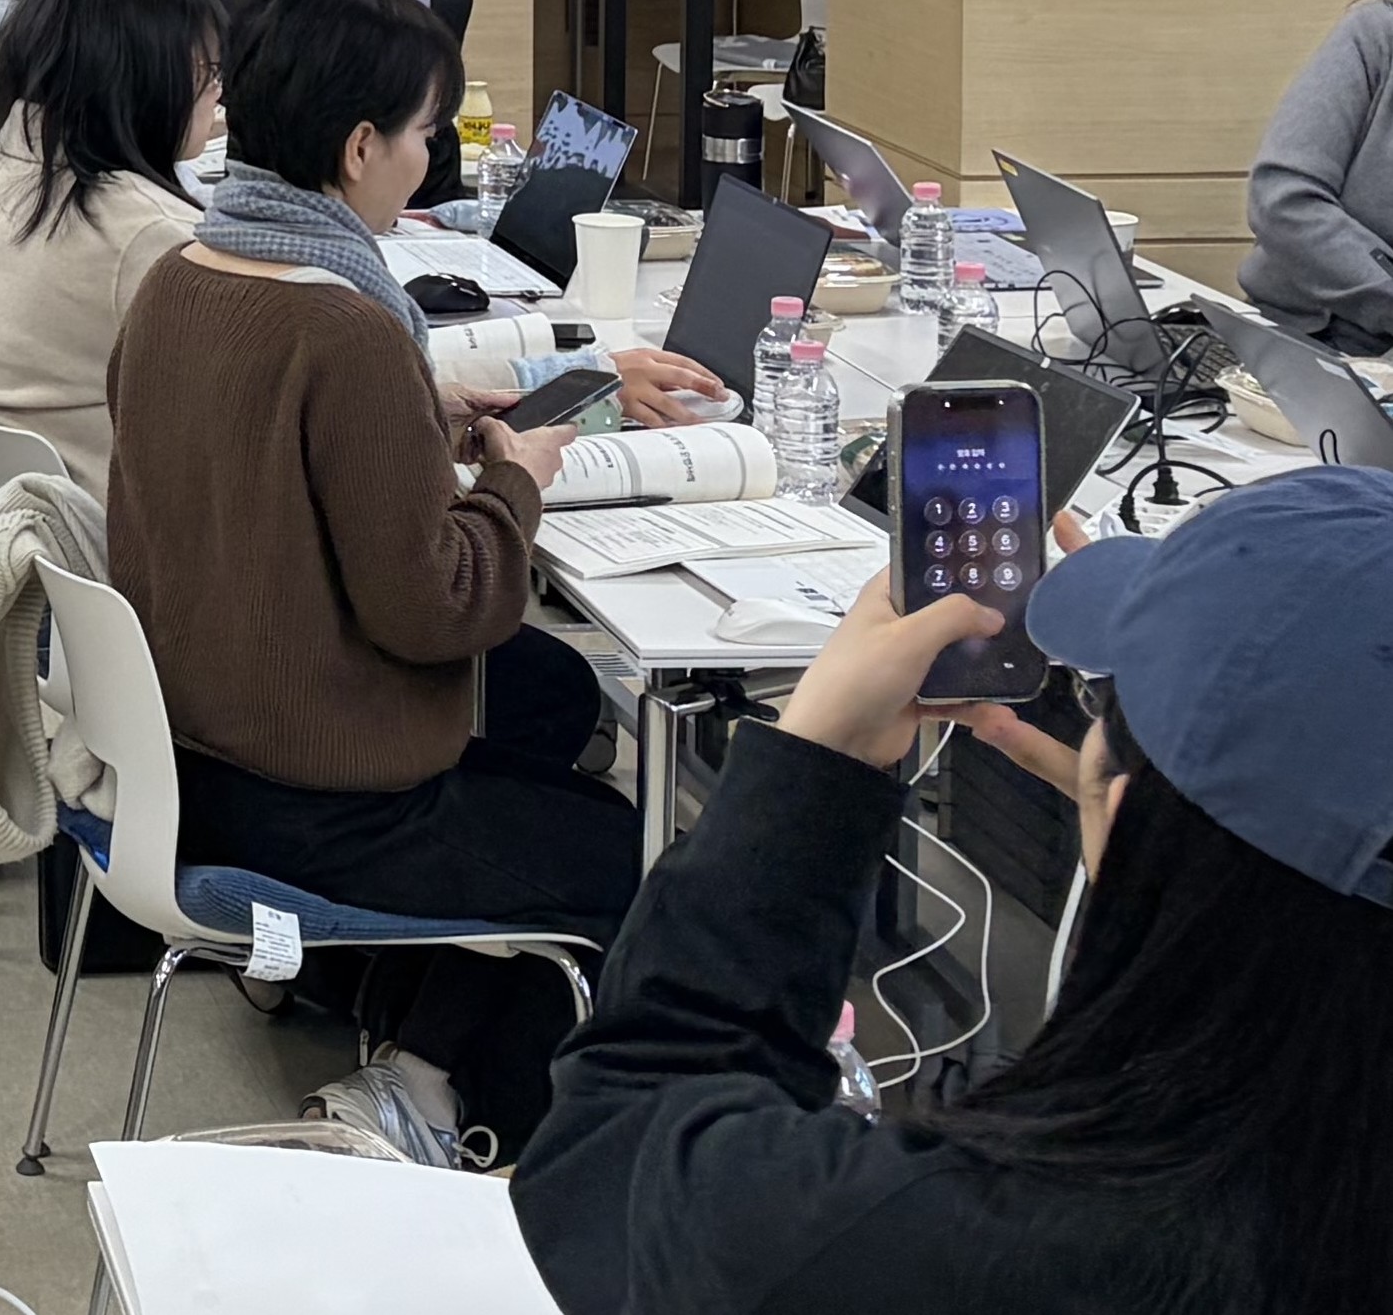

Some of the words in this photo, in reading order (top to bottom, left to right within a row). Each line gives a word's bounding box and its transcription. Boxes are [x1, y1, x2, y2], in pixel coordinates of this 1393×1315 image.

[935, 503, 942, 514] 1
[967, 502, 976, 514] 2
[1001, 501, 1010, 512] 3
[934, 536, 944, 547] 4
[968, 535, 977, 547] 5
[1001, 534, 1011, 546] 6
[934, 569, 944, 581] 7
[968, 568, 978, 579] 8
[1003, 568, 1013, 580] 9
